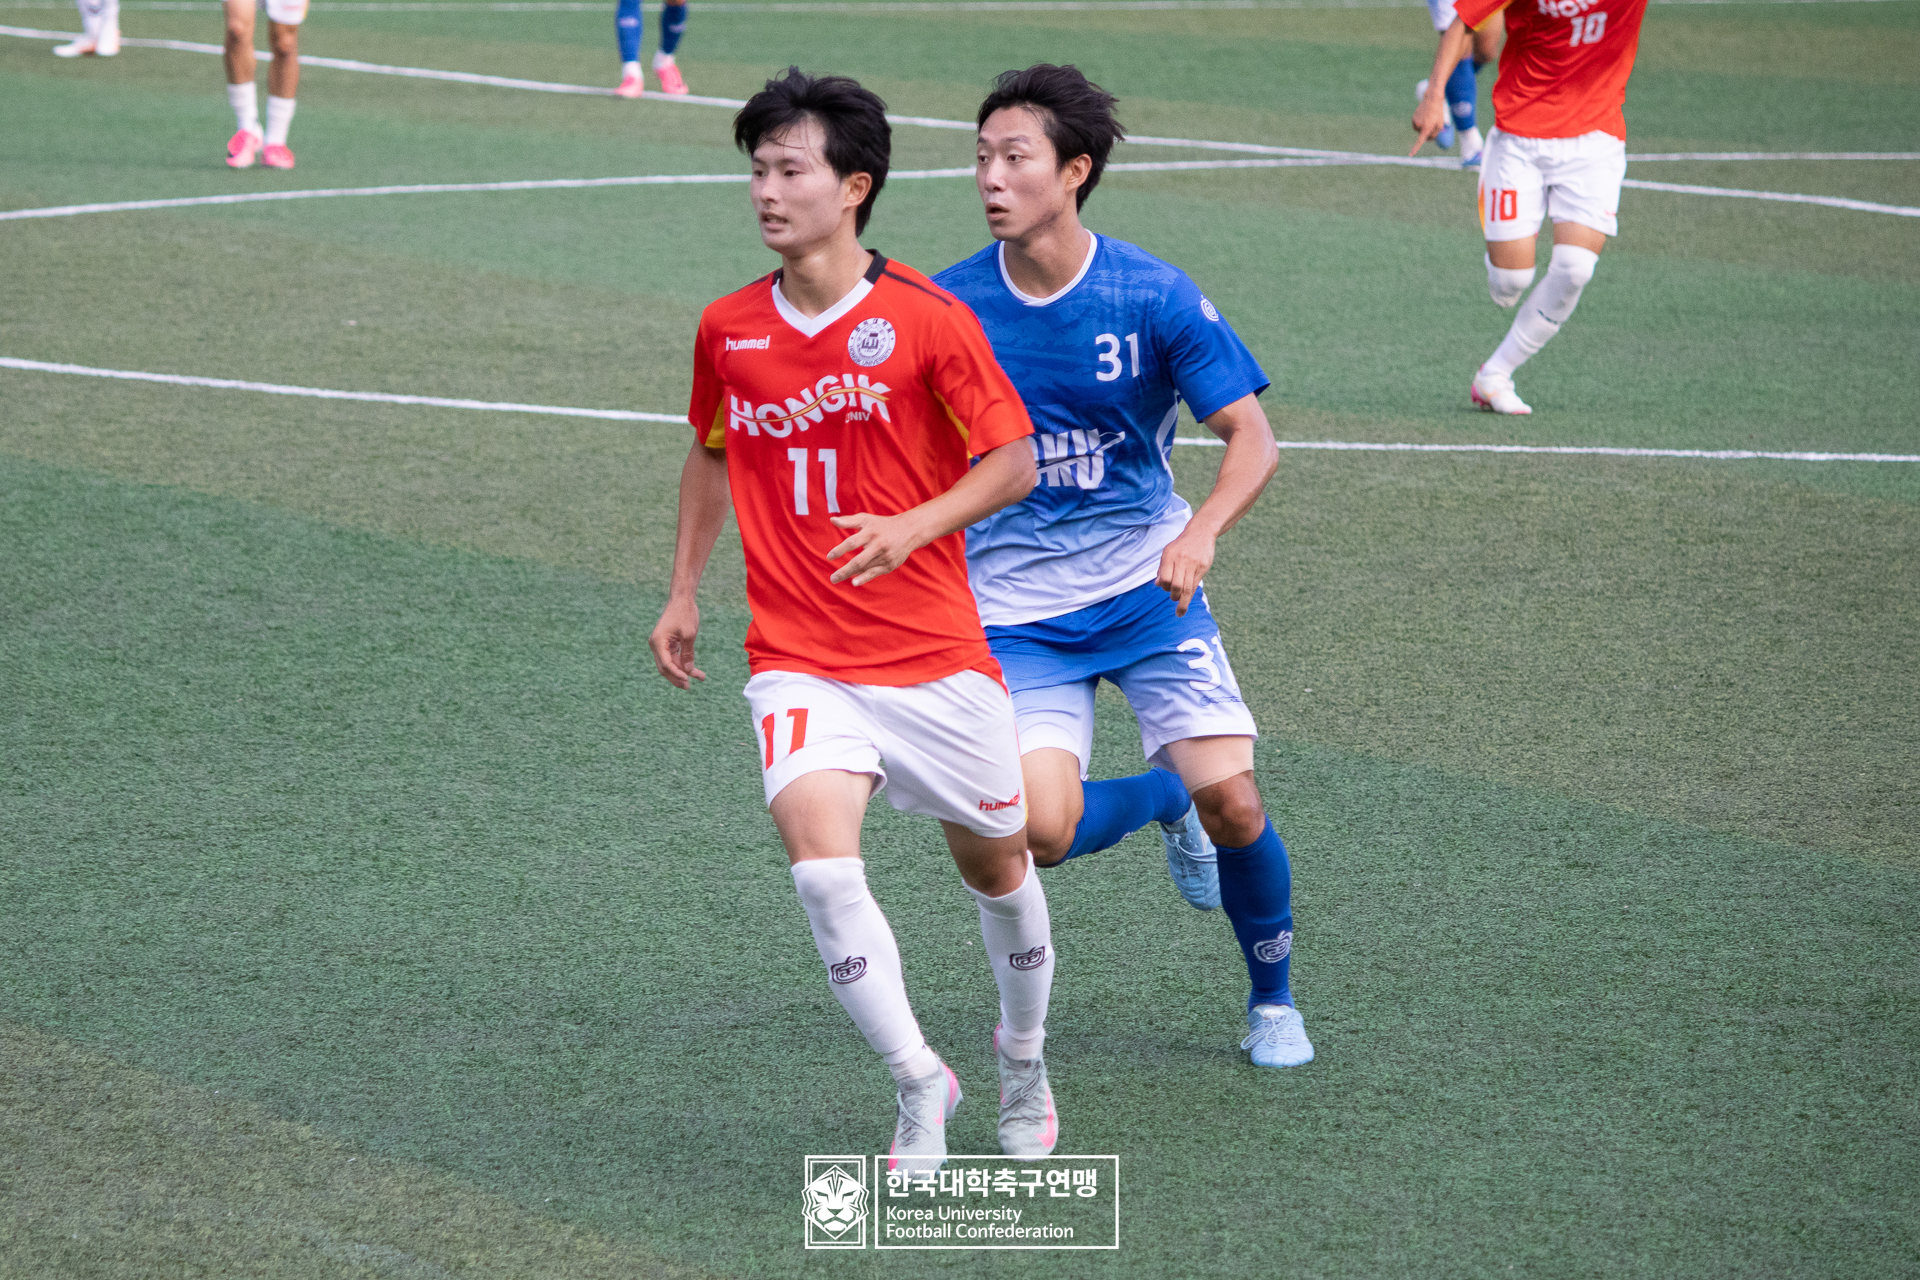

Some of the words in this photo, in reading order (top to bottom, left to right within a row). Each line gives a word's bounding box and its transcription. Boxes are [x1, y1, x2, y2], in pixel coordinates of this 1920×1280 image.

[1569, 11, 1608, 47] 10
[1490, 188, 1518, 222] 10
[725, 335, 771, 351] hummel
[1094, 332, 1140, 382] 31
[729, 373, 892, 438] HONGIK
[787, 447, 841, 515] 11
[1027, 428, 1104, 490] KU
[1176, 635, 1238, 691] 31
[760, 708, 809, 771] 11
